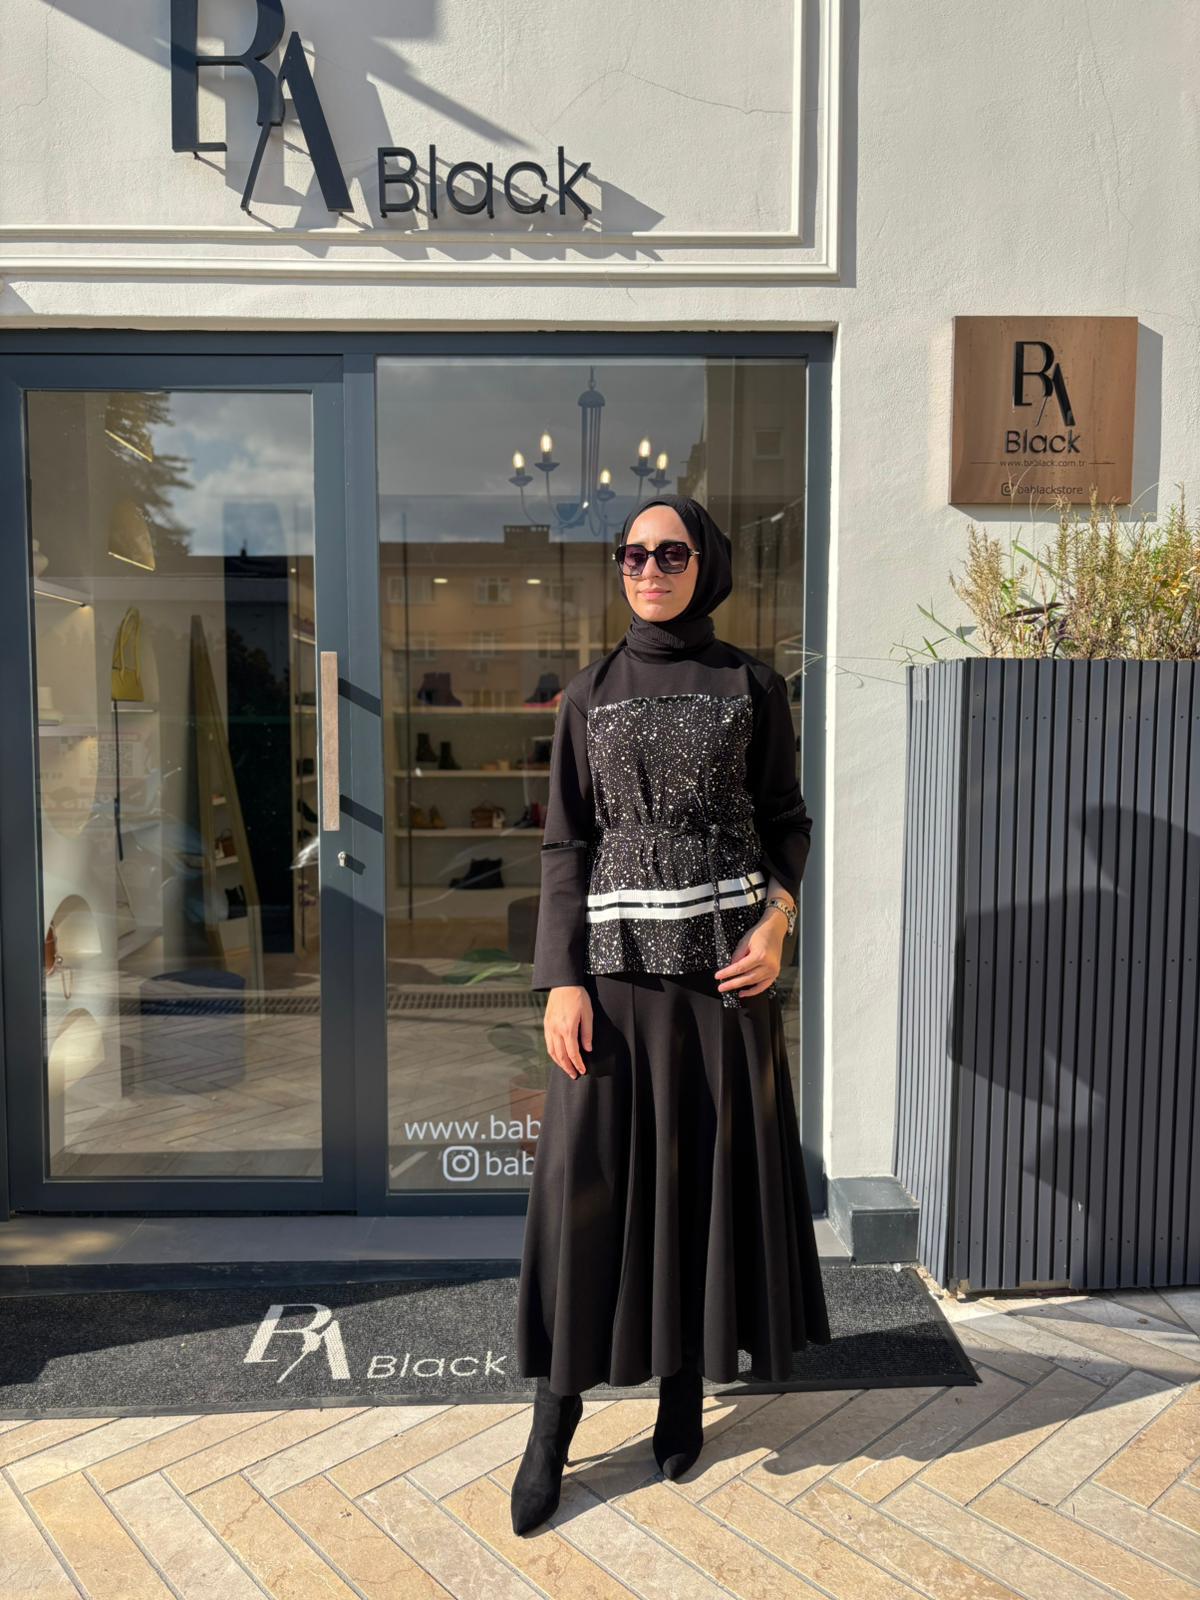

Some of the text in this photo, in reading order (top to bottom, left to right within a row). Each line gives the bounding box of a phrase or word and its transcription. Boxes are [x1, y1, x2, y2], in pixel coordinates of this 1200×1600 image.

[377, 144, 592, 217] Black
[1005, 429, 1081, 453] Black
[1000, 459, 1086, 467] www.bablack.com.tr
[1017, 484, 1083, 495] bablackstore
[366, 1350, 507, 1379] Black
